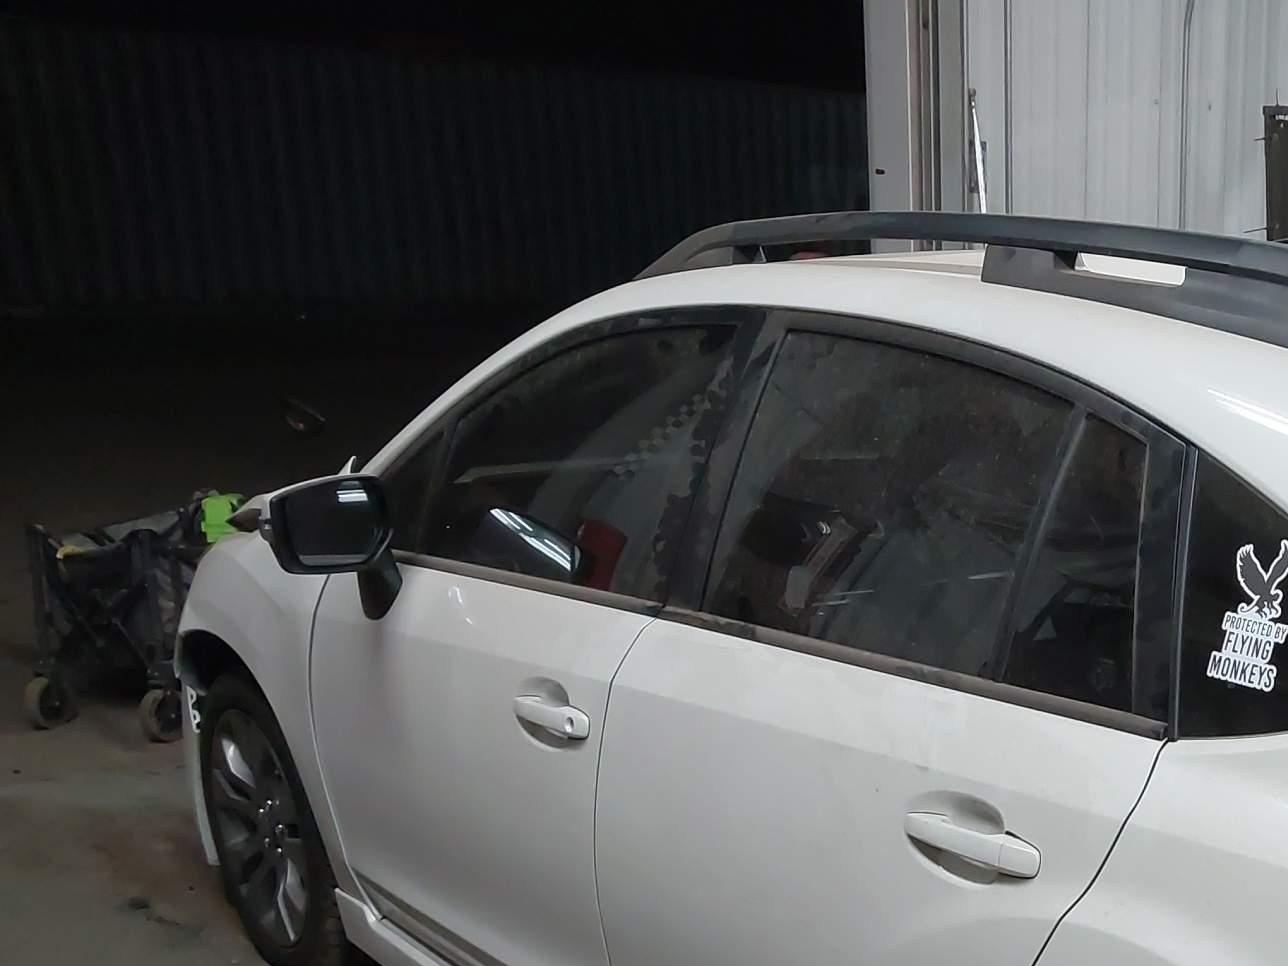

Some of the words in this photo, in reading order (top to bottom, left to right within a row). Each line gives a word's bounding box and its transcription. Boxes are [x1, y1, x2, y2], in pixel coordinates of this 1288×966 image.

[1224, 614, 1273, 638] PROTECTED
[1274, 626, 1288, 641] BY
[1224, 631, 1272, 661] FLYING
[1208, 654, 1275, 689] MONKEYS
